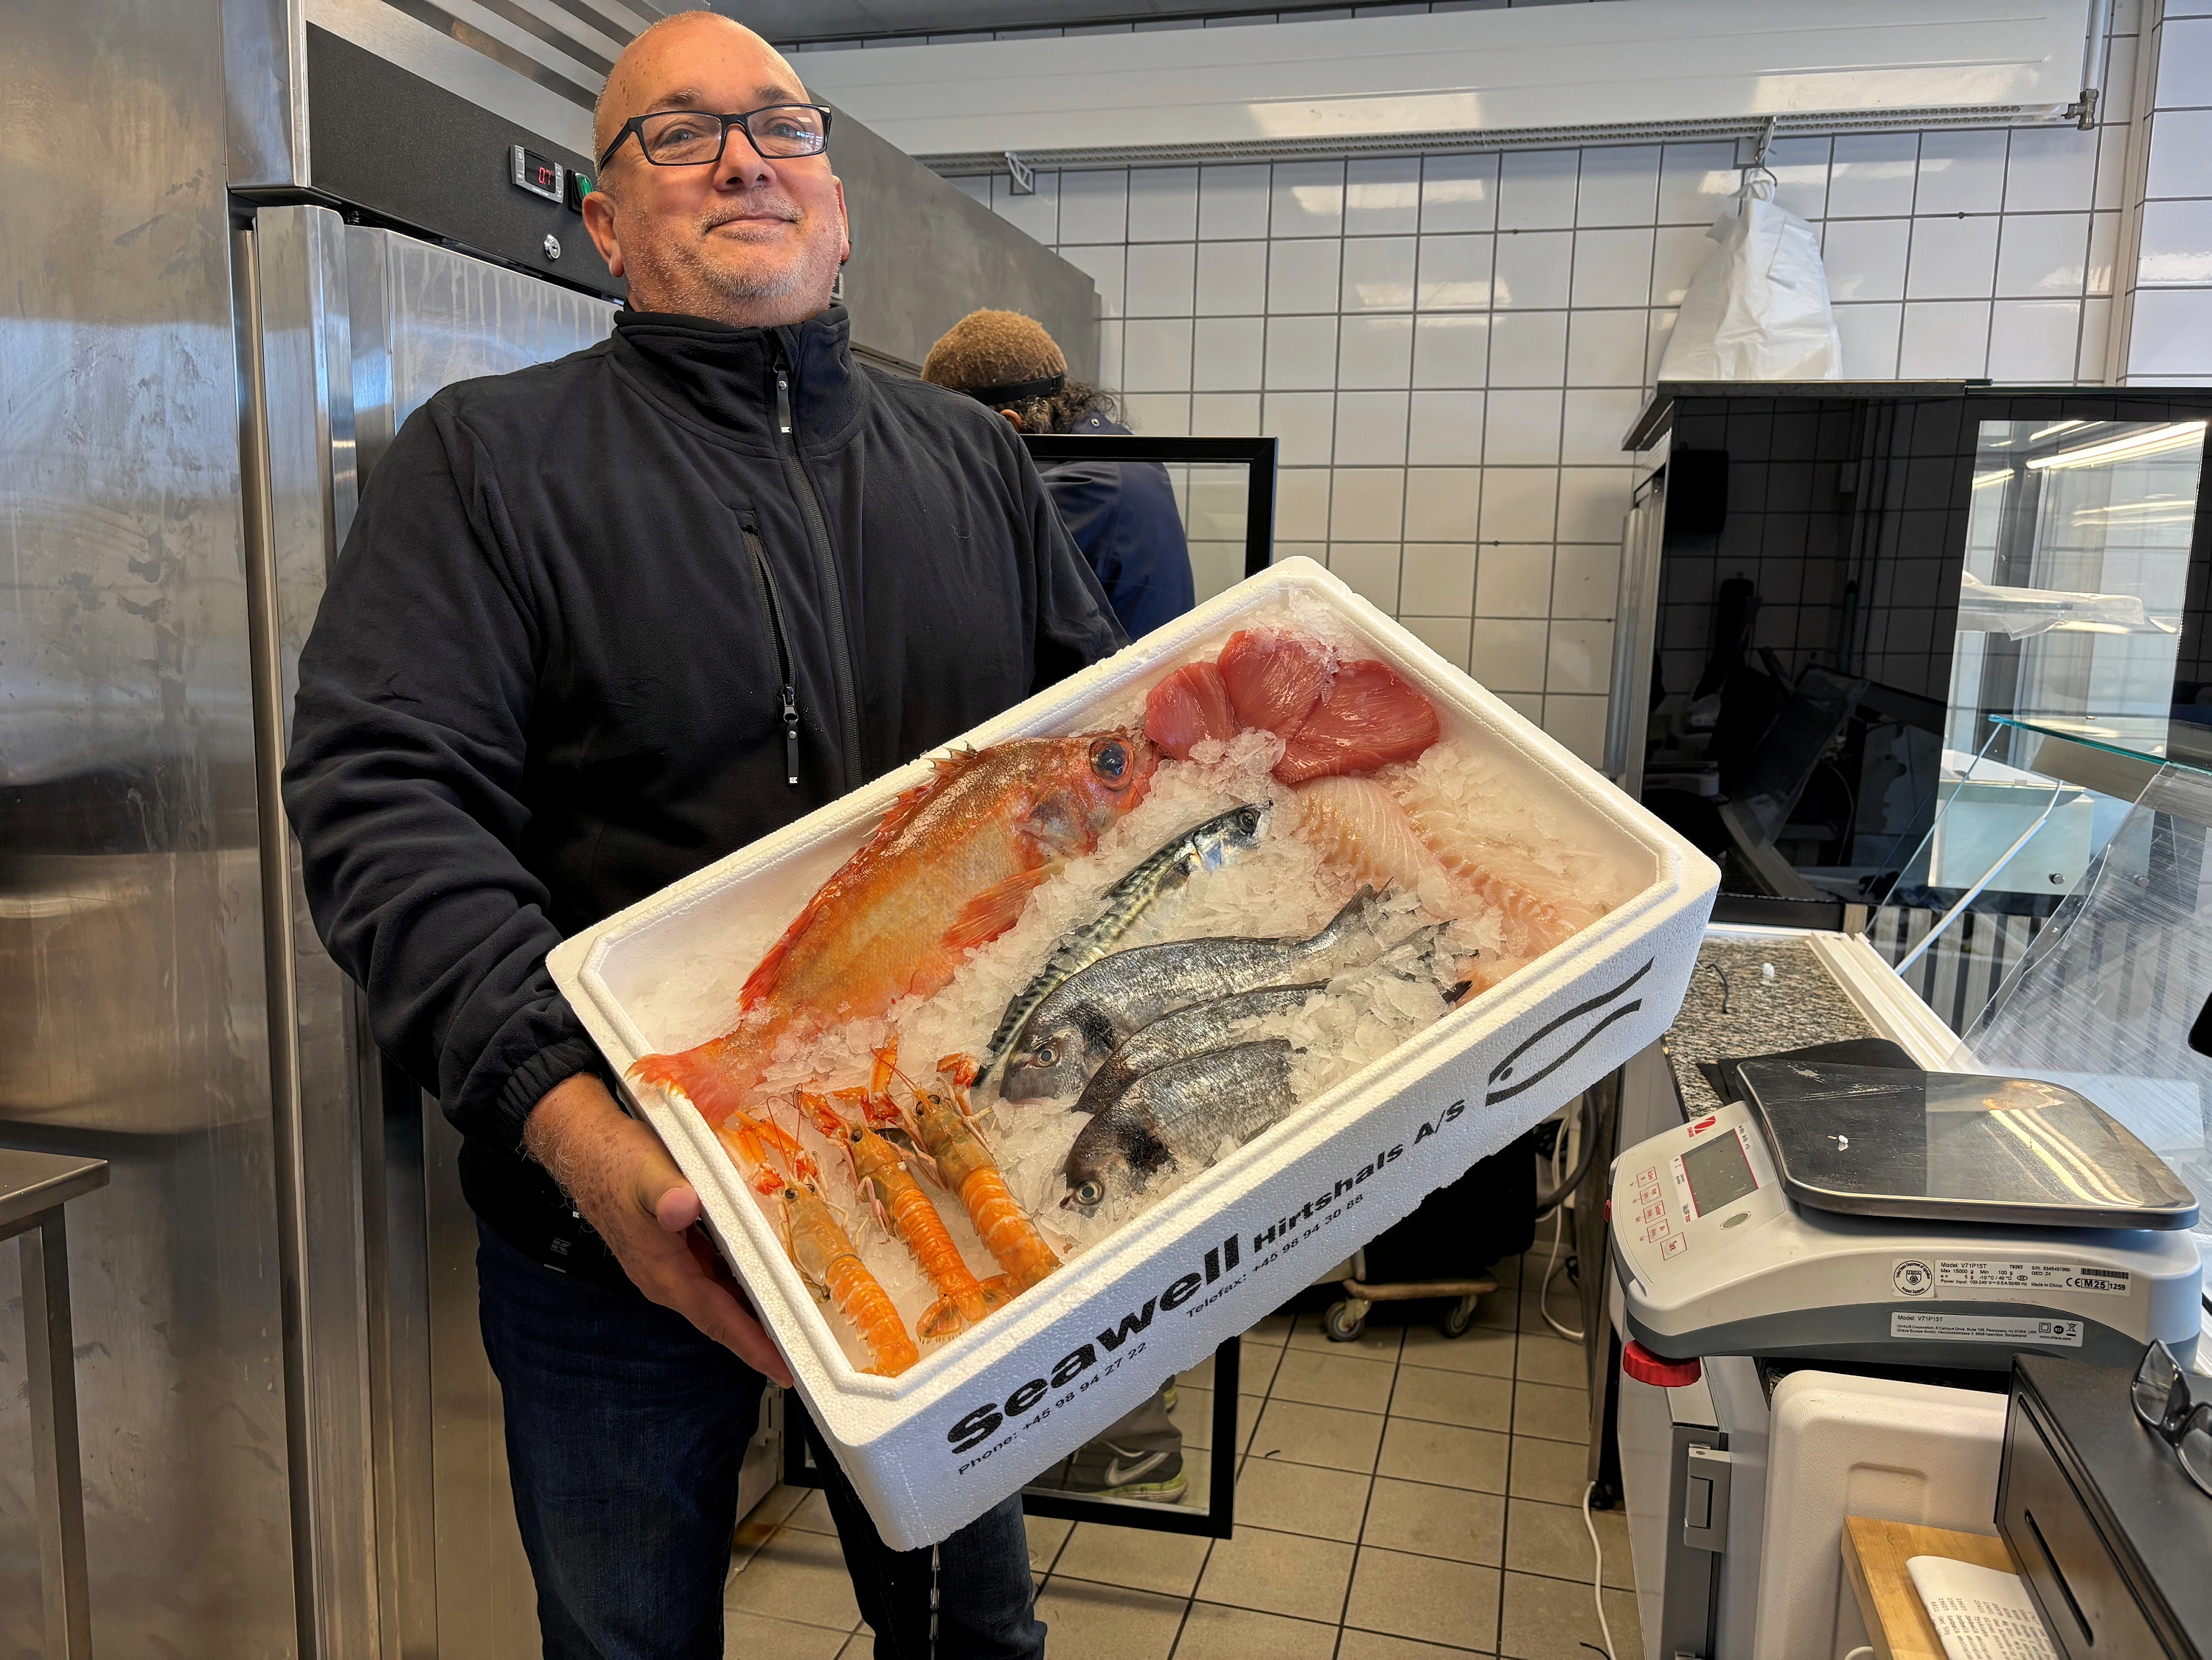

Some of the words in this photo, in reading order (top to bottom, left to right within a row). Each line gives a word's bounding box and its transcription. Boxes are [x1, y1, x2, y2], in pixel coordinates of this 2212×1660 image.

[947, 1233, 1239, 1454] Seawell
[1253, 1145, 1402, 1253] Hirtshals
[1413, 1100, 1464, 1146] A/S
[1186, 1274, 1246, 1317] Telefax:
[1252, 1252, 1277, 1272] +45
[1282, 1237, 1299, 1253] 98
[1304, 1223, 1320, 1239] 94
[1325, 1208, 1341, 1224] 30
[1346, 1194, 1363, 1209] 88
[959, 1432, 1018, 1475] Phone:
[1023, 1408, 1050, 1431] +45
[1056, 1392, 1075, 1408] 98
[1079, 1375, 1100, 1392] 94
[1105, 1358, 1122, 1376] 27
[1128, 1342, 1146, 1360] 22
